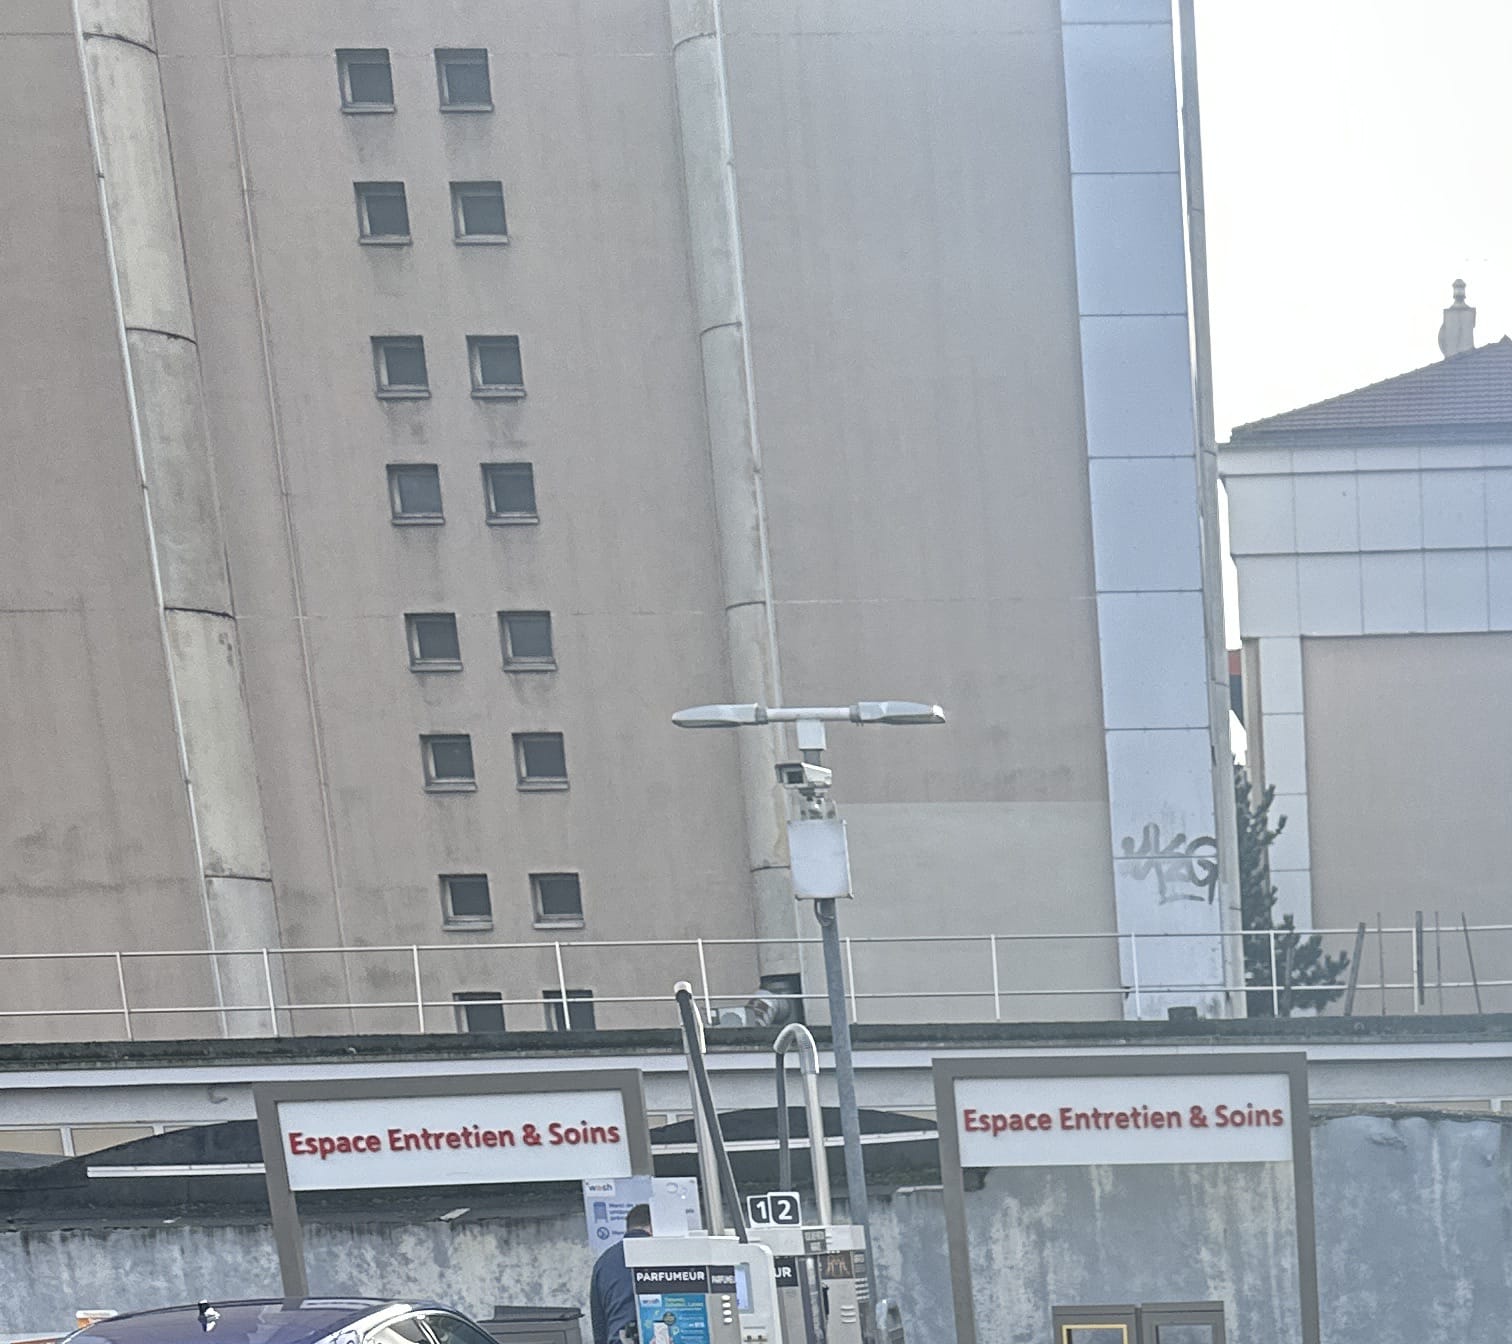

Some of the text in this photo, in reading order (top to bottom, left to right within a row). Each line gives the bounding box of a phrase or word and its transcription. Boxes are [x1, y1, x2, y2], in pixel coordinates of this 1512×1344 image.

[963, 1102, 1284, 1137] Espace Entretien & Soins
[288, 1119, 621, 1160] Espace Entretien & Soins
[756, 1200, 768, 1220] 1
[777, 1199, 793, 1220] 2
[636, 1271, 705, 1282] PARFUMEUR
